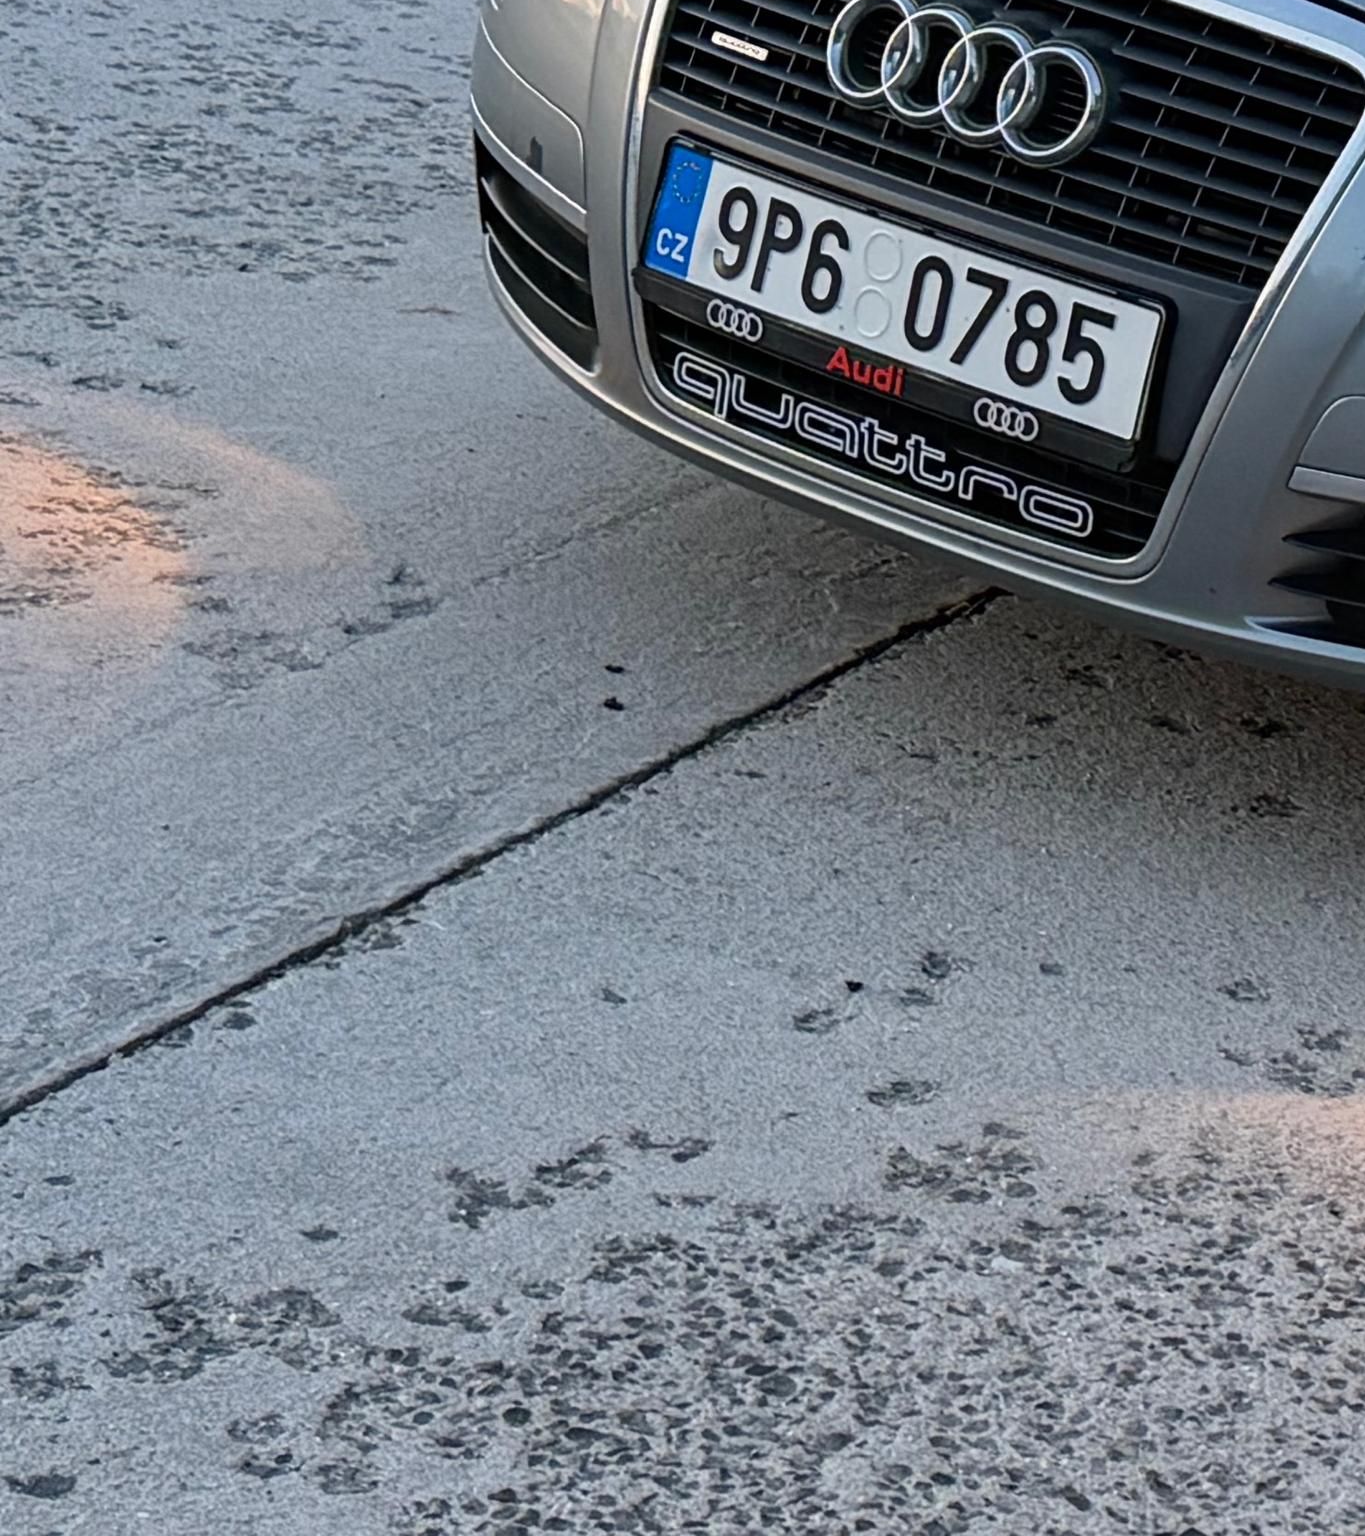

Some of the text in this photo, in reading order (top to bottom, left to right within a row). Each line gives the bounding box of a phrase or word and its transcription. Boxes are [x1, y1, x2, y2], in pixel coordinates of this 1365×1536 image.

[655, 226, 687, 263] CZ
[712, 186, 1117, 405] 9P6 0785
[825, 346, 906, 397] Audi
[672, 350, 1093, 538] quattro
